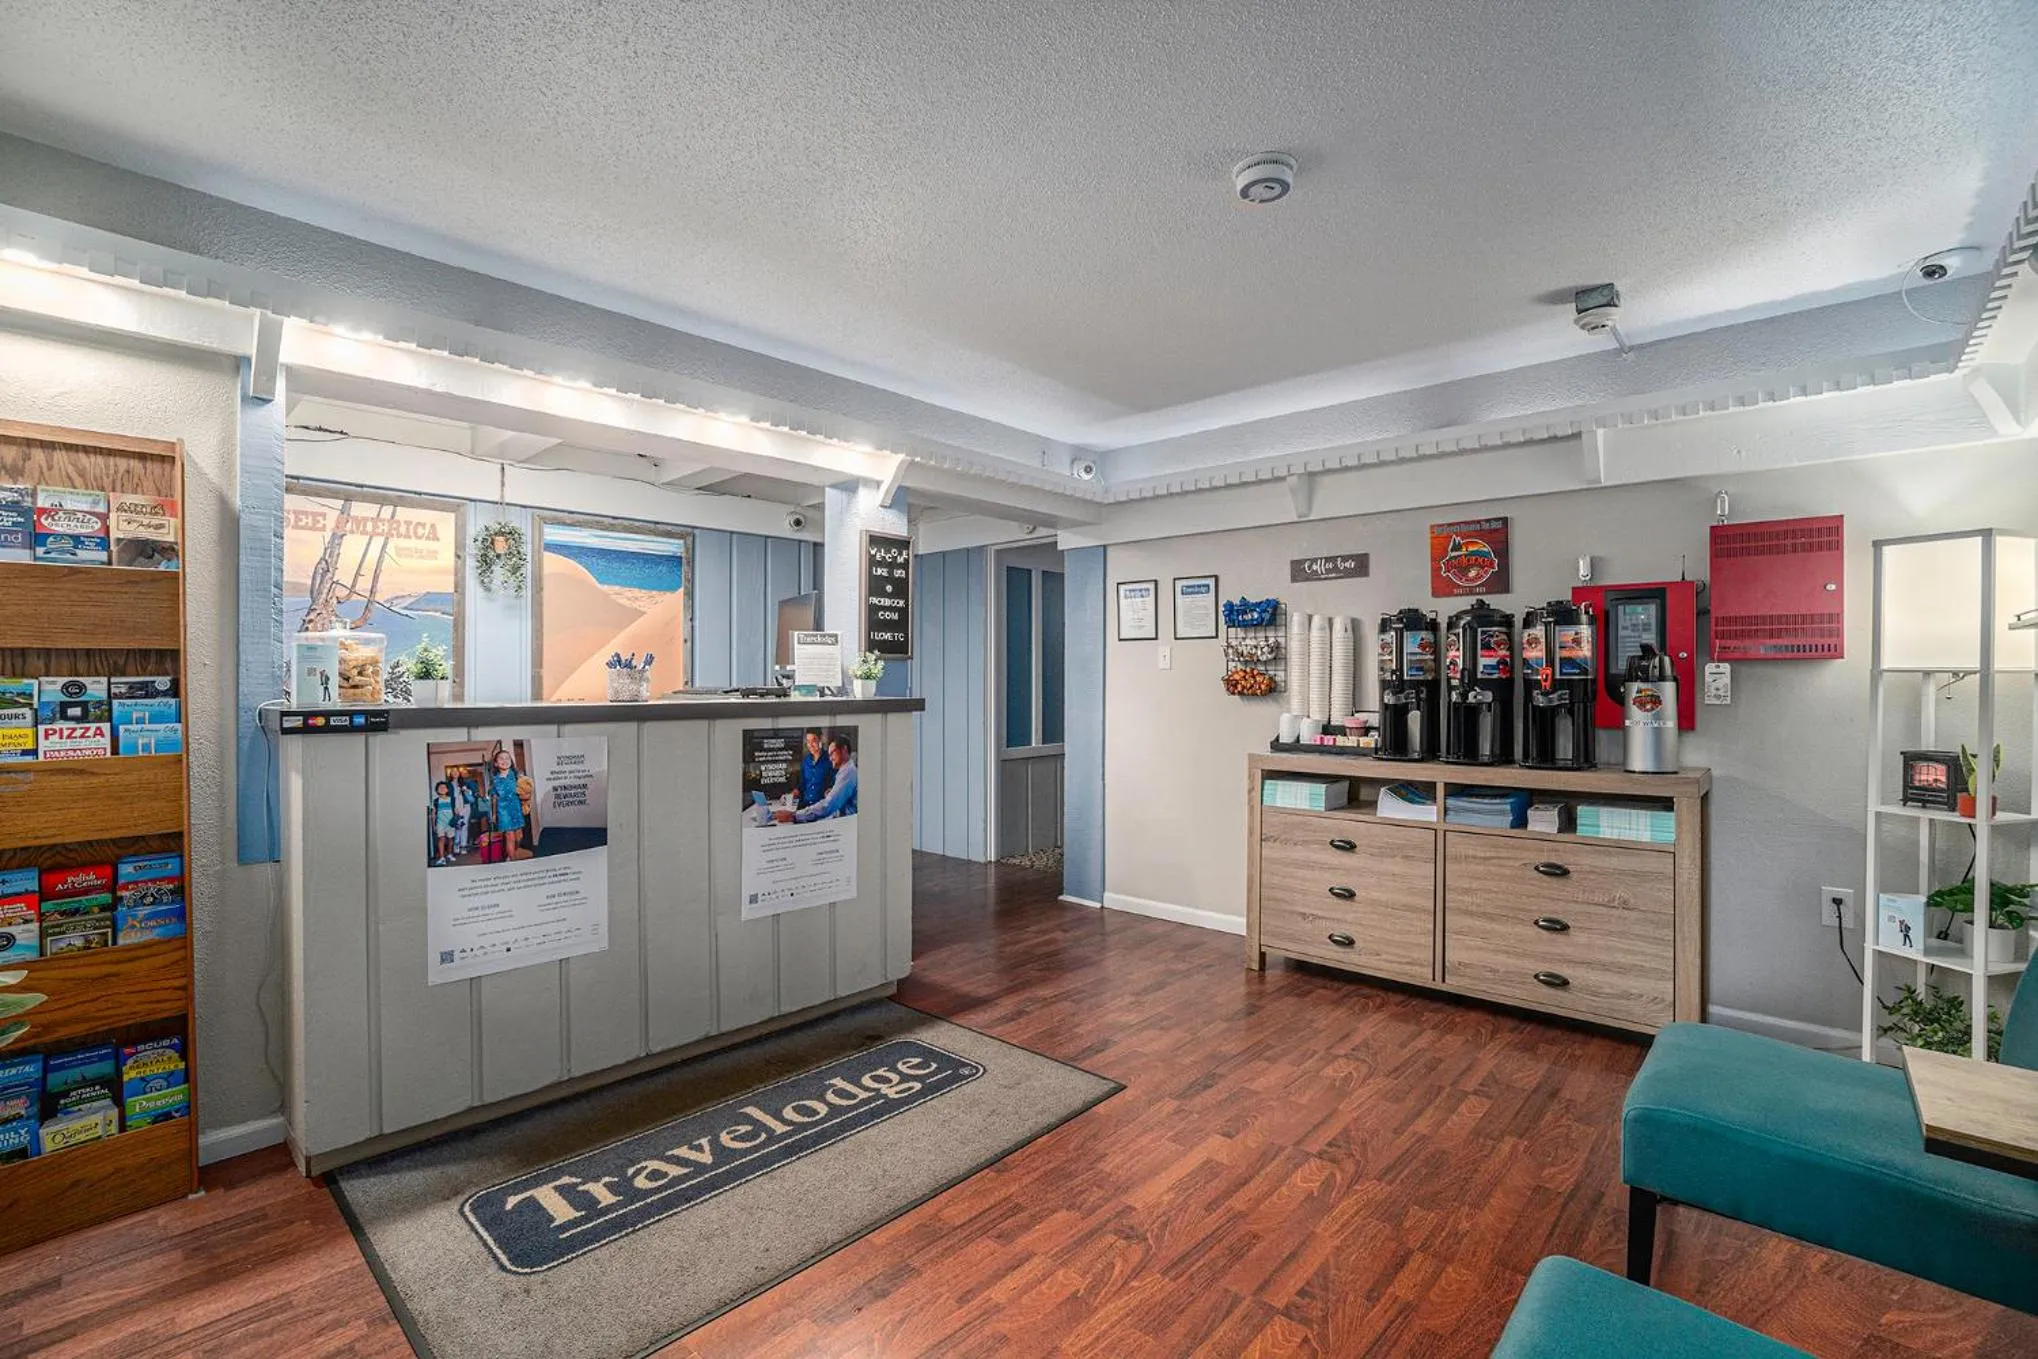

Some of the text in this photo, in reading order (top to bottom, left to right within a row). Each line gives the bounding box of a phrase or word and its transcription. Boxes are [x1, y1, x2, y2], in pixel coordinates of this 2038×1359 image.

[333, 513, 440, 542] AMERICA
[869, 547, 909, 564] WELCOME
[872, 566, 906, 579] LIKE US
[1303, 558, 1335, 576] Coffee
[1336, 556, 1356, 570] bar
[869, 596, 906, 608] FACEBOOK
[878, 611, 899, 621] COM
[44, 726, 105, 741] PIZZA
[552, 783, 589, 793] WYNDHAM
[553, 791, 588, 801] REWARDS
[67, 872, 96, 883] Polish
[55, 878, 108, 891] Art Center
[136, 1037, 179, 1052] SCUBA
[504, 1053, 938, 1229] Travelodge
